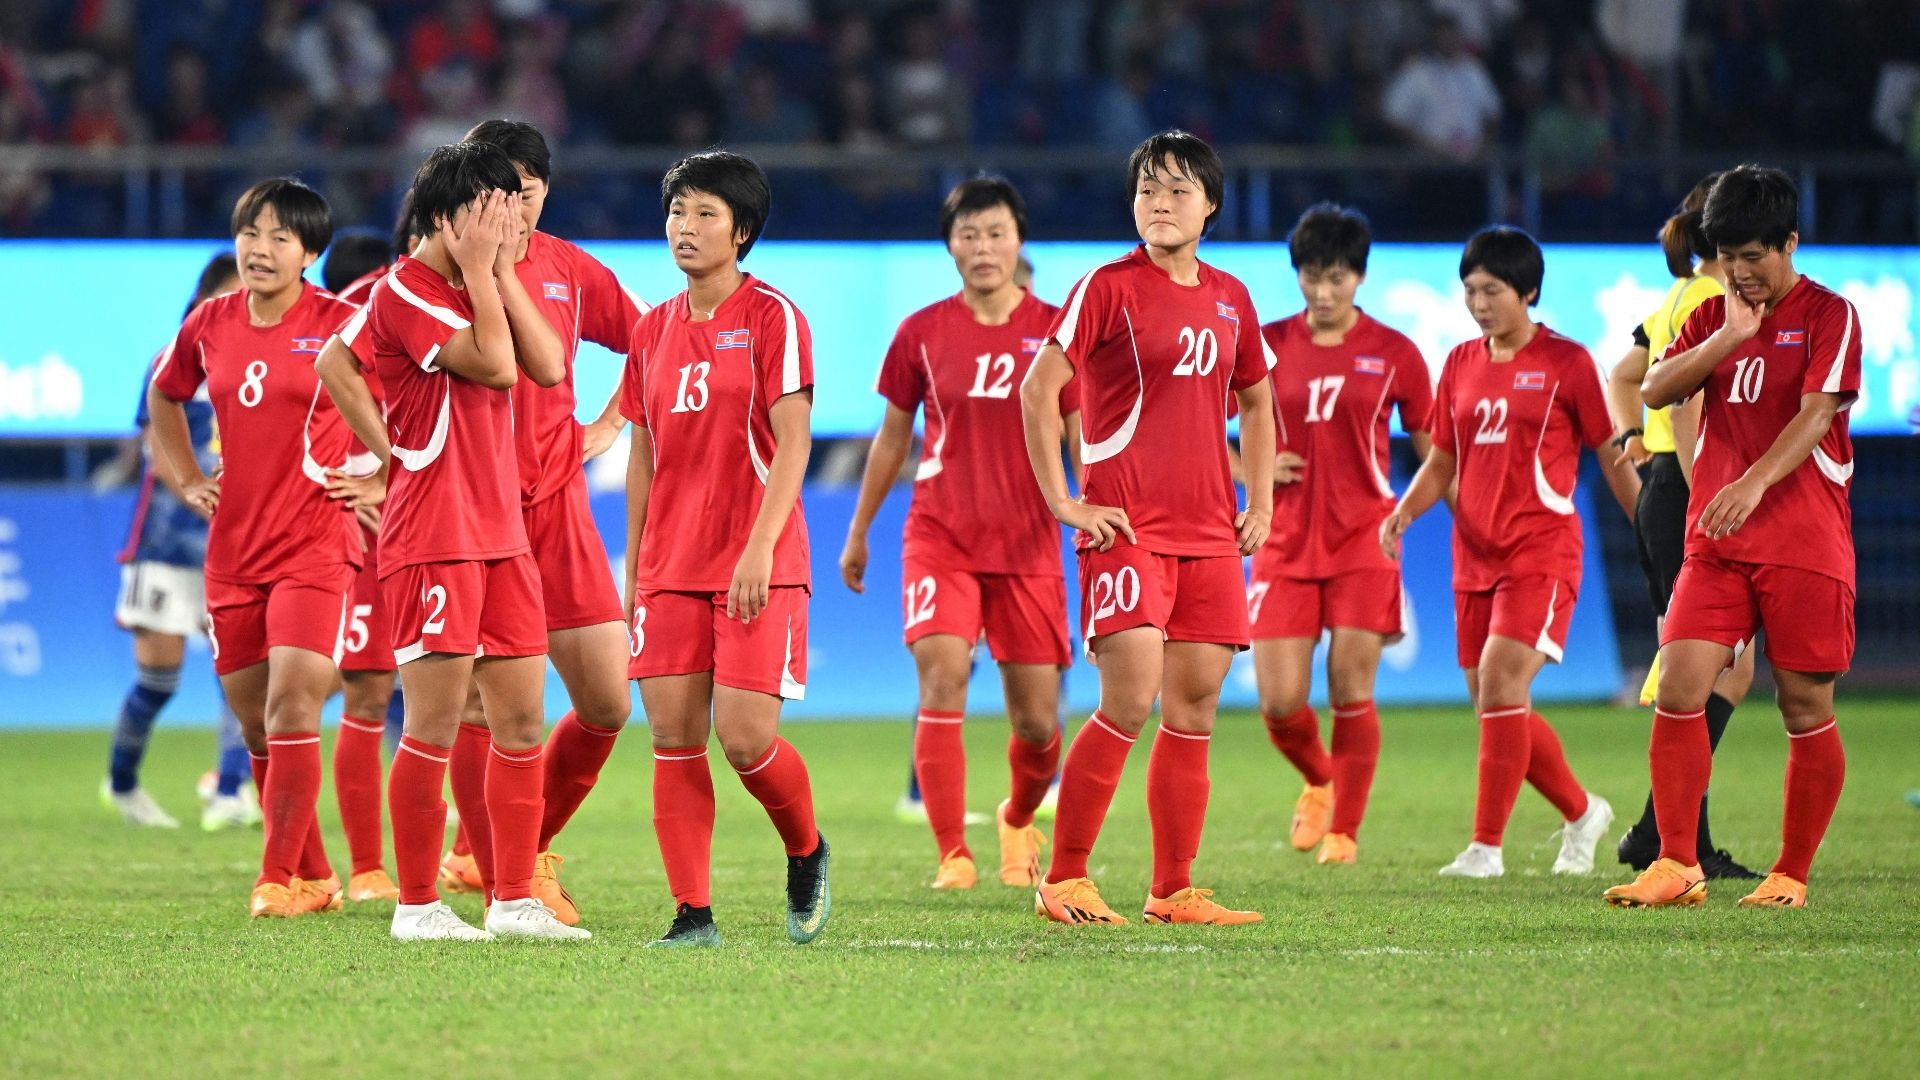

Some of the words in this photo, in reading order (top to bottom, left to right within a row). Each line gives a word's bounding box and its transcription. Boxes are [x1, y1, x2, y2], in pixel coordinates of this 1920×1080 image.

[967, 353, 1015, 399] 12
[1172, 326, 1218, 377] 20
[238, 360, 268, 408] 8
[670, 361, 711, 414] 13
[1305, 375, 1345, 422] 17
[1727, 356, 1765, 403] 10
[1474, 397, 1508, 444] 22
[421, 584, 447, 635] 2
[903, 575, 937, 630] 12
[1094, 564, 1141, 621] 20
